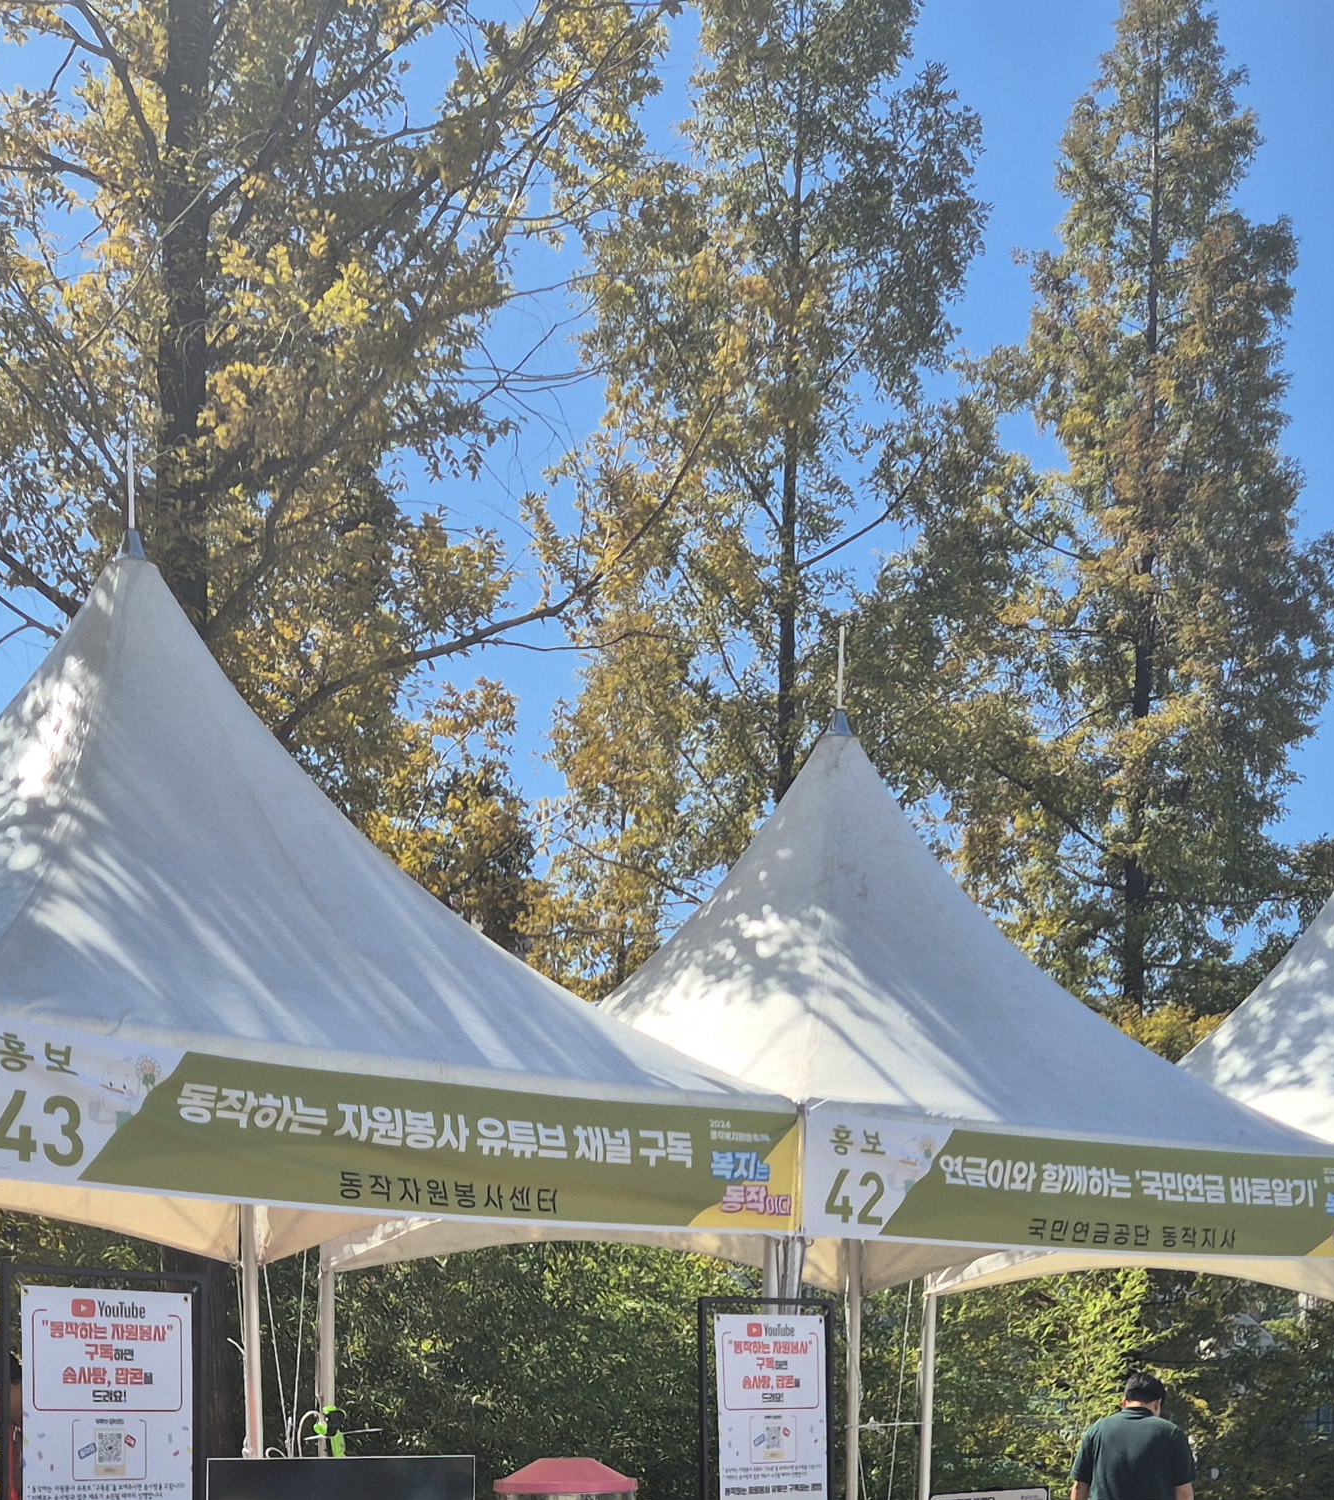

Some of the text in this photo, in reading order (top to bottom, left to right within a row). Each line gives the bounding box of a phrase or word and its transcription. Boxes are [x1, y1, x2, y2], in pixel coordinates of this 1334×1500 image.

[177, 1083, 693, 1168] 동작하는 자원봉사 유튜브 채널 구독
[709, 1119, 731, 1129] 2024
[710, 1150, 771, 1181] 복지는
[938, 1154, 1037, 1192] 연금이와
[1040, 1162, 1132, 1199] 함께하는
[339, 1170, 558, 1214] 동작자원봉사센터
[720, 1184, 793, 1216] 동작이다
[824, 1168, 885, 1226] 42
[1028, 1217, 1236, 1250] 국민연금공단 동작지사
[98, 1300, 146, 1319] YouTube
[764, 1323, 795, 1337] YouTube
[84, 1343, 134, 1361] 구독하면
[62, 1366, 111, 1387] 솜사탕,
[92, 1389, 127, 1403] 드려요!
